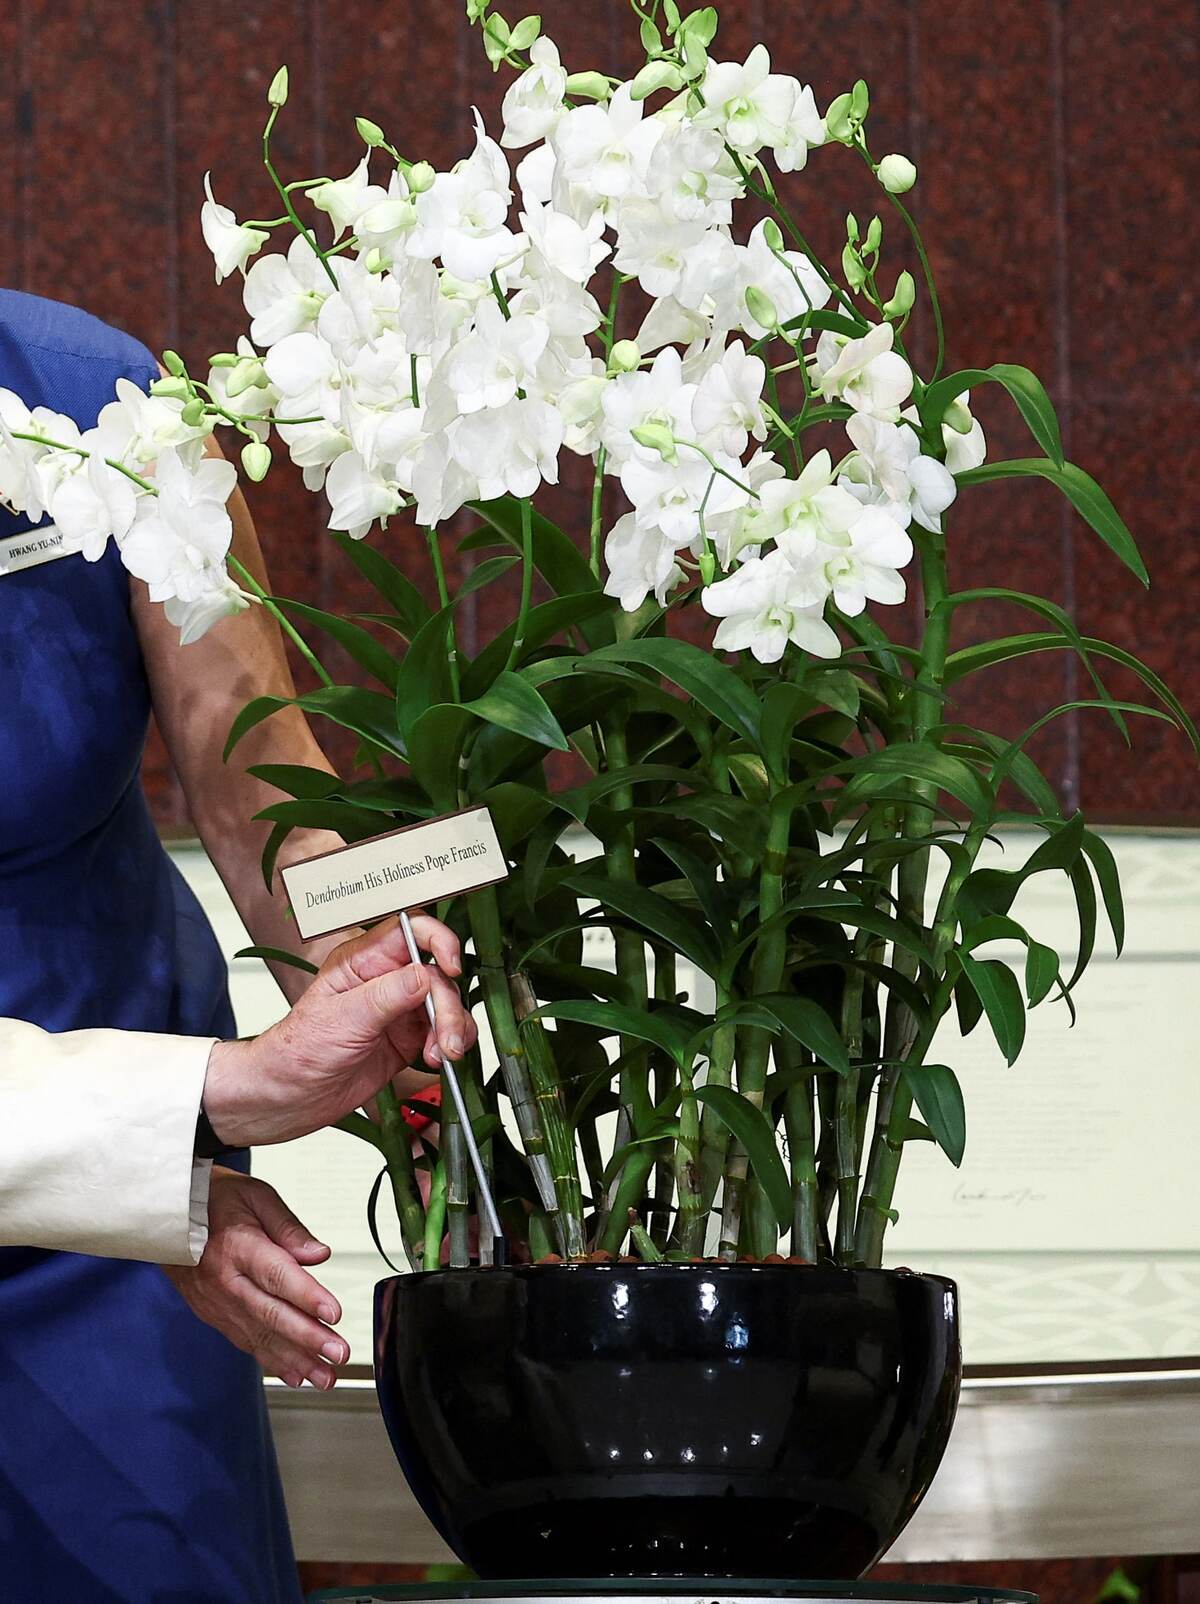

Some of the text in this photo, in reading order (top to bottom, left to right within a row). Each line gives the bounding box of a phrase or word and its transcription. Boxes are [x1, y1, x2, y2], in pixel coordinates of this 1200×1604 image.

[9, 543, 37, 558] HWANG
[305, 839, 487, 908] Dendrobium His Holiness Pope Francis
